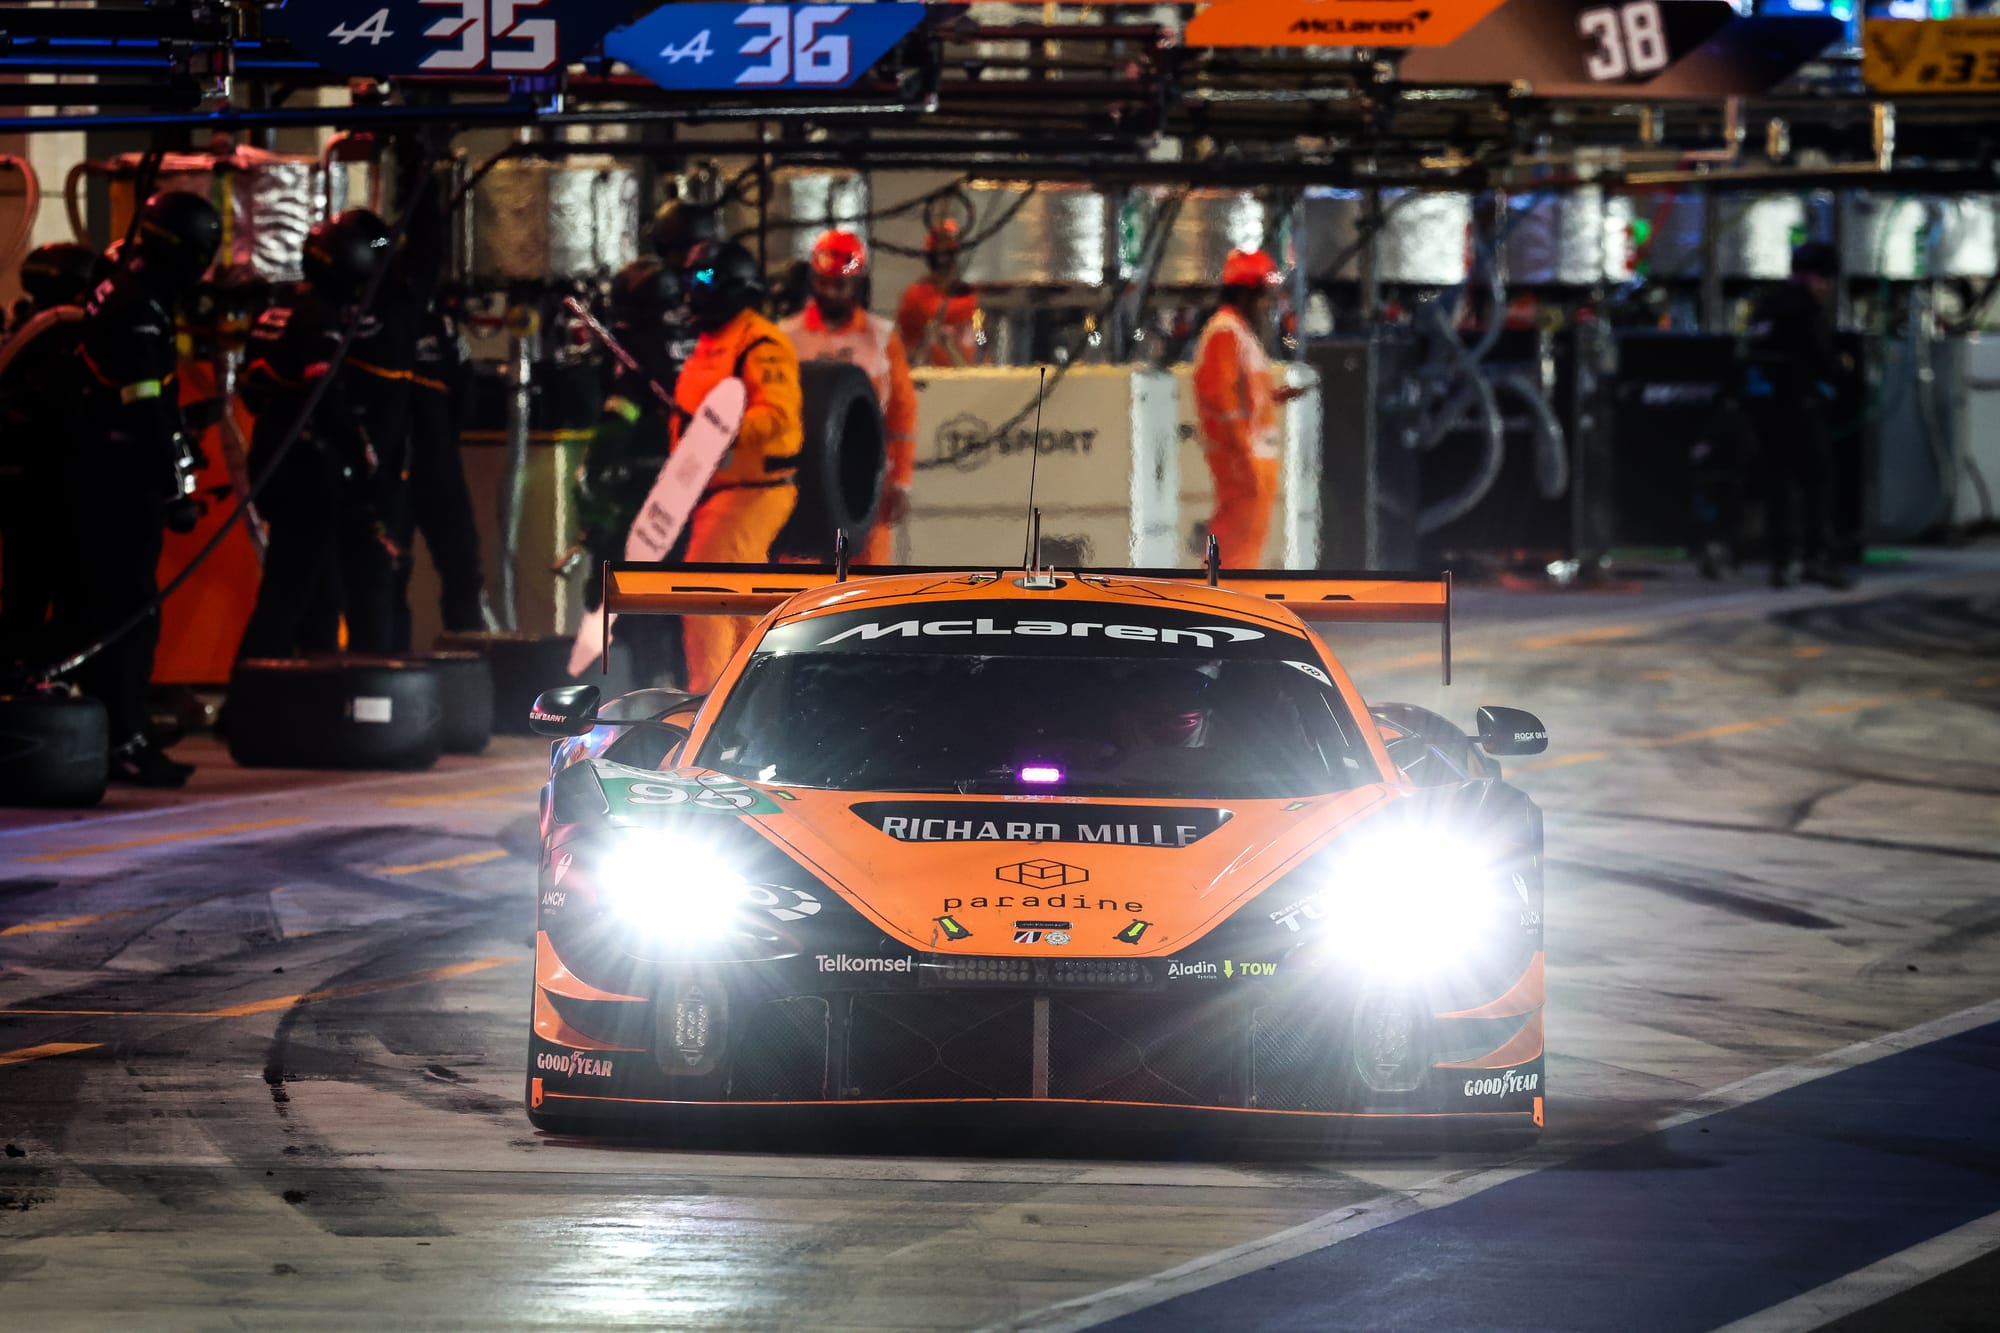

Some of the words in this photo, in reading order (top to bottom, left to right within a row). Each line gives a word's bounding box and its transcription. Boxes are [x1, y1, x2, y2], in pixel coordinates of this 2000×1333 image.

[417, 0, 559, 71] 35
[1288, 14, 1420, 34] McLaren
[734, 6, 851, 84] 36
[1580, 1, 1668, 81] 38
[816, 618, 1216, 648] McLaren
[1514, 732, 1534, 740] ROCK
[627, 782, 755, 811] 95
[882, 816, 1060, 840] RICHARD
[1078, 823, 1197, 846] MILLE
[944, 894, 1143, 913] paradine
[815, 953, 912, 973] Telkomsel
[1167, 961, 1217, 976] Aladin
[1239, 963, 1277, 976] TOW
